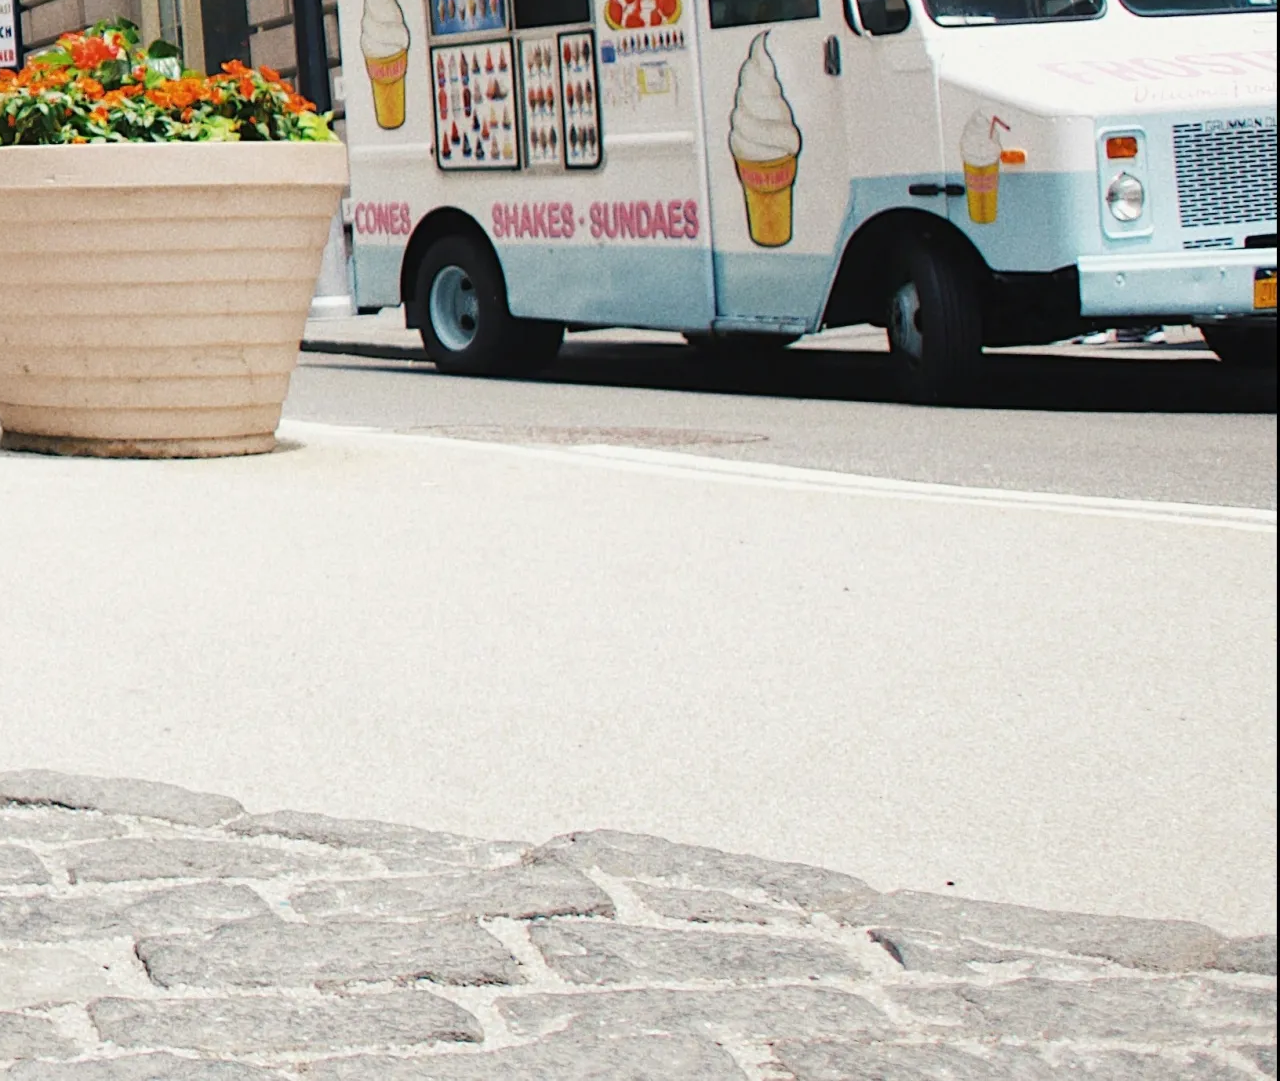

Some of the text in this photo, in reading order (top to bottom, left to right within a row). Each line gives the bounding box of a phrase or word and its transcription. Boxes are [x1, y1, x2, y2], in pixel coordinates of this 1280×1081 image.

[354, 201, 412, 236] CONES
[491, 199, 701, 239] SHAKES SUNDAES
